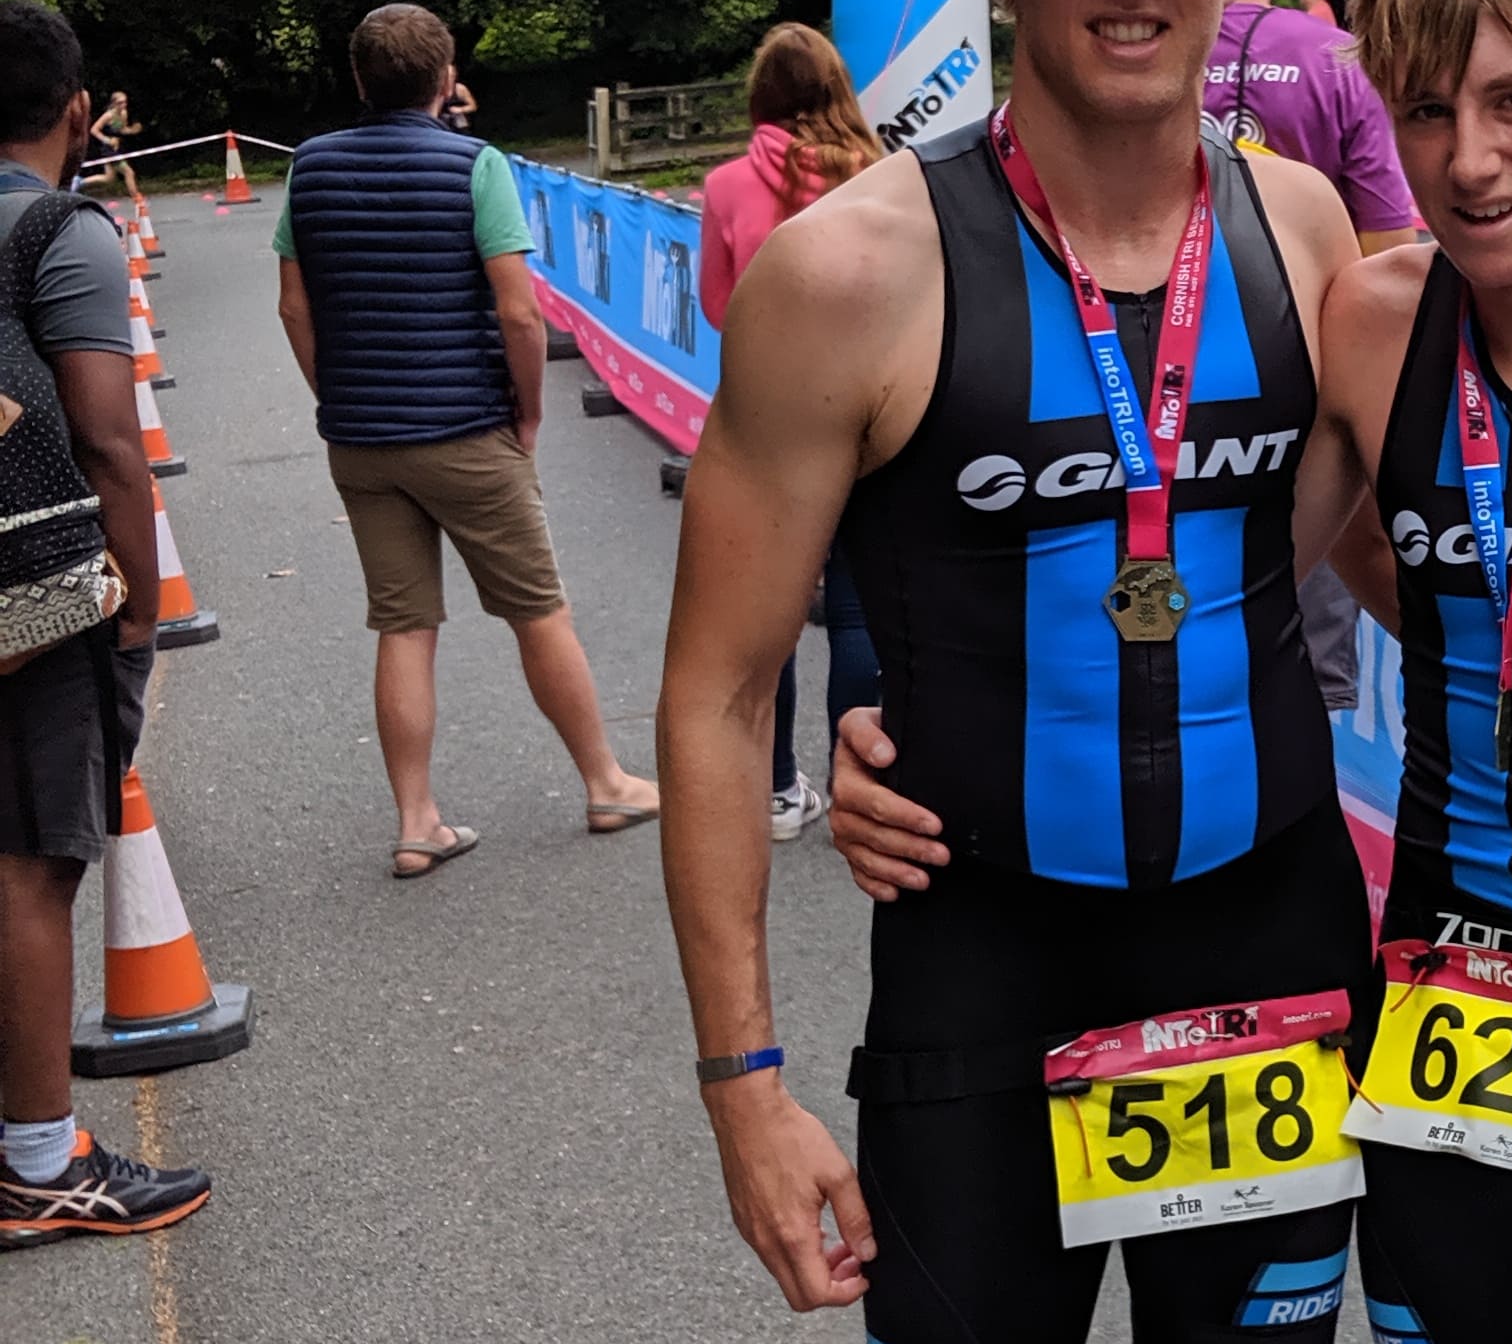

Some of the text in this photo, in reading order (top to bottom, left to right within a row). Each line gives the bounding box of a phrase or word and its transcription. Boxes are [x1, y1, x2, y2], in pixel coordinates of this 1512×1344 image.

[1180, 240, 1197, 261] TRI
[1171, 263, 1191, 326] CORNISH
[1097, 347, 1147, 476] intoTRI.com
[1106, 1060, 1314, 1183] 518
[1427, 1126, 1466, 1145] BETTER
[1160, 1198, 1203, 1219] BETTER
